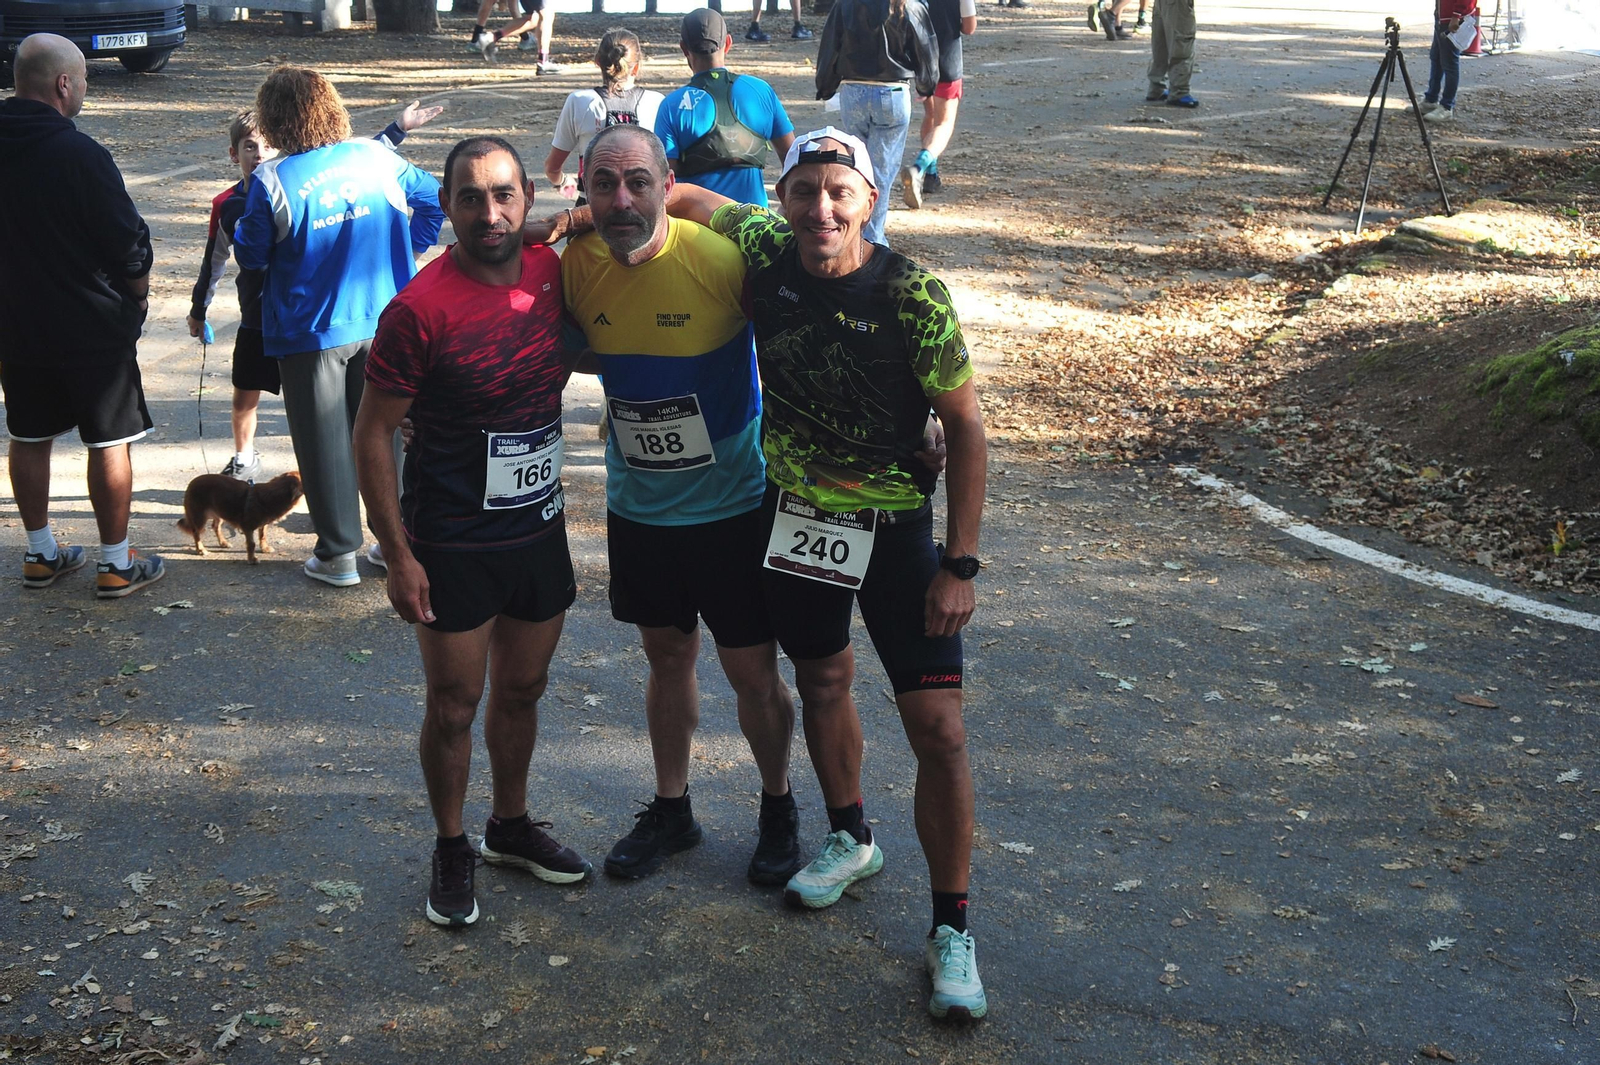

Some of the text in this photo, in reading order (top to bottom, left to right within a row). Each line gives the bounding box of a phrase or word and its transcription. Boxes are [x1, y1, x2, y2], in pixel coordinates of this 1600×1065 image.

[101, 34, 145, 48] 1778 KFX
[312, 205, 371, 231] MORAÑA
[656, 313, 691, 321] FIND YOUR
[657, 320, 685, 328] EVEREST
[846, 318, 879, 334] RST
[657, 405, 680, 416] 14KM
[663, 410, 692, 421] ADVENTURE
[659, 423, 682, 432] IGLESIAS
[497, 438, 517, 446] TRAIL
[634, 431, 685, 456] 188
[516, 457, 537, 467] ANTONIO
[512, 457, 552, 490] 166
[787, 494, 805, 505] TRAIL
[834, 511, 857, 522] 21KM
[824, 516, 864, 530] TRAIL ADVANCE
[804, 524, 844, 538] JULIO MARQUEZ
[789, 530, 850, 565] 240
